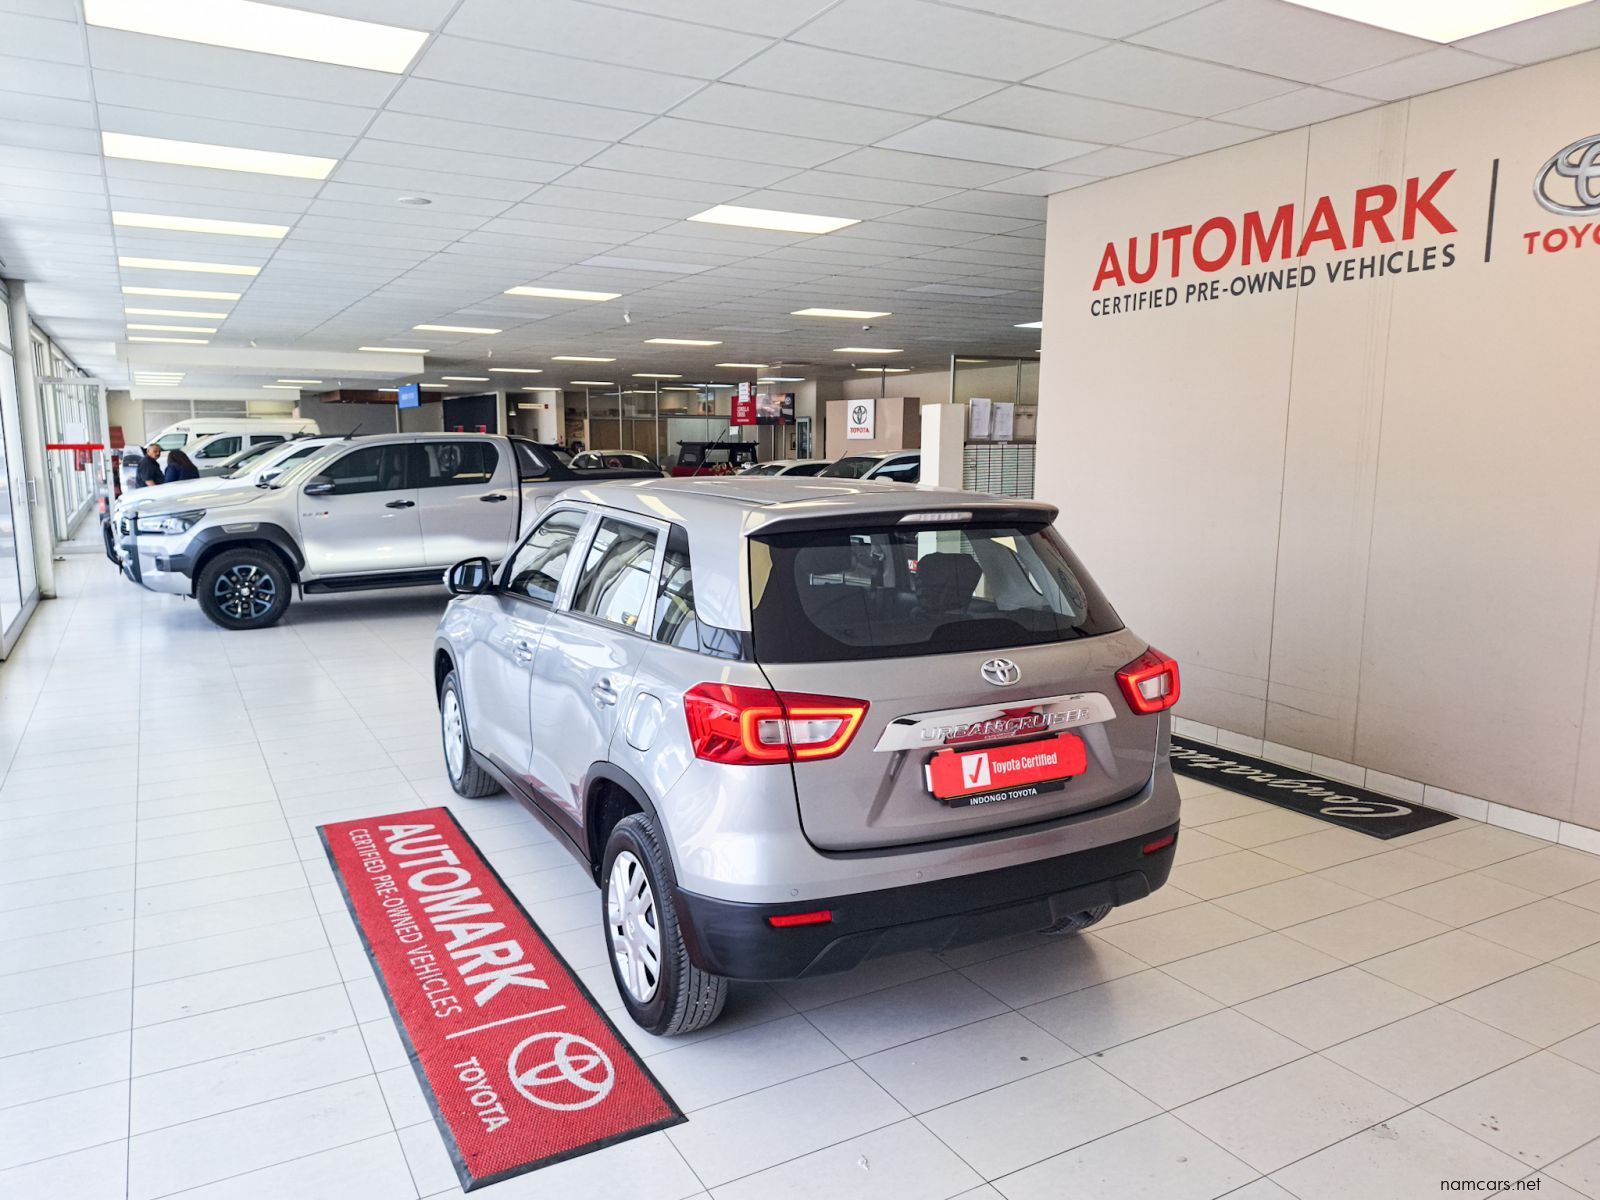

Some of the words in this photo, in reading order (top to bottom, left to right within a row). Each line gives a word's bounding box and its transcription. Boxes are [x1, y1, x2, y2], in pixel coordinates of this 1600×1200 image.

[1092, 169, 1457, 291] AUTOMARK
[1523, 223, 1600, 255] TOY
[1090, 287, 1178, 317] CERTIFIED
[1185, 265, 1316, 304] PRE-OWNED
[1326, 243, 1456, 283] VEHICLES
[970, 793, 1007, 806] INDONGO
[1008, 788, 1038, 799] TOYOTA
[992, 758, 1020, 774] Toyota
[1021, 752, 1058, 769] Certified
[348, 828, 387, 874] CERTIFIED
[371, 874, 424, 944] PRE-OWNED
[406, 944, 463, 1019] VEHICLES
[378, 823, 550, 1008] AUTOMARK
[453, 1055, 511, 1134] TOYOTA
